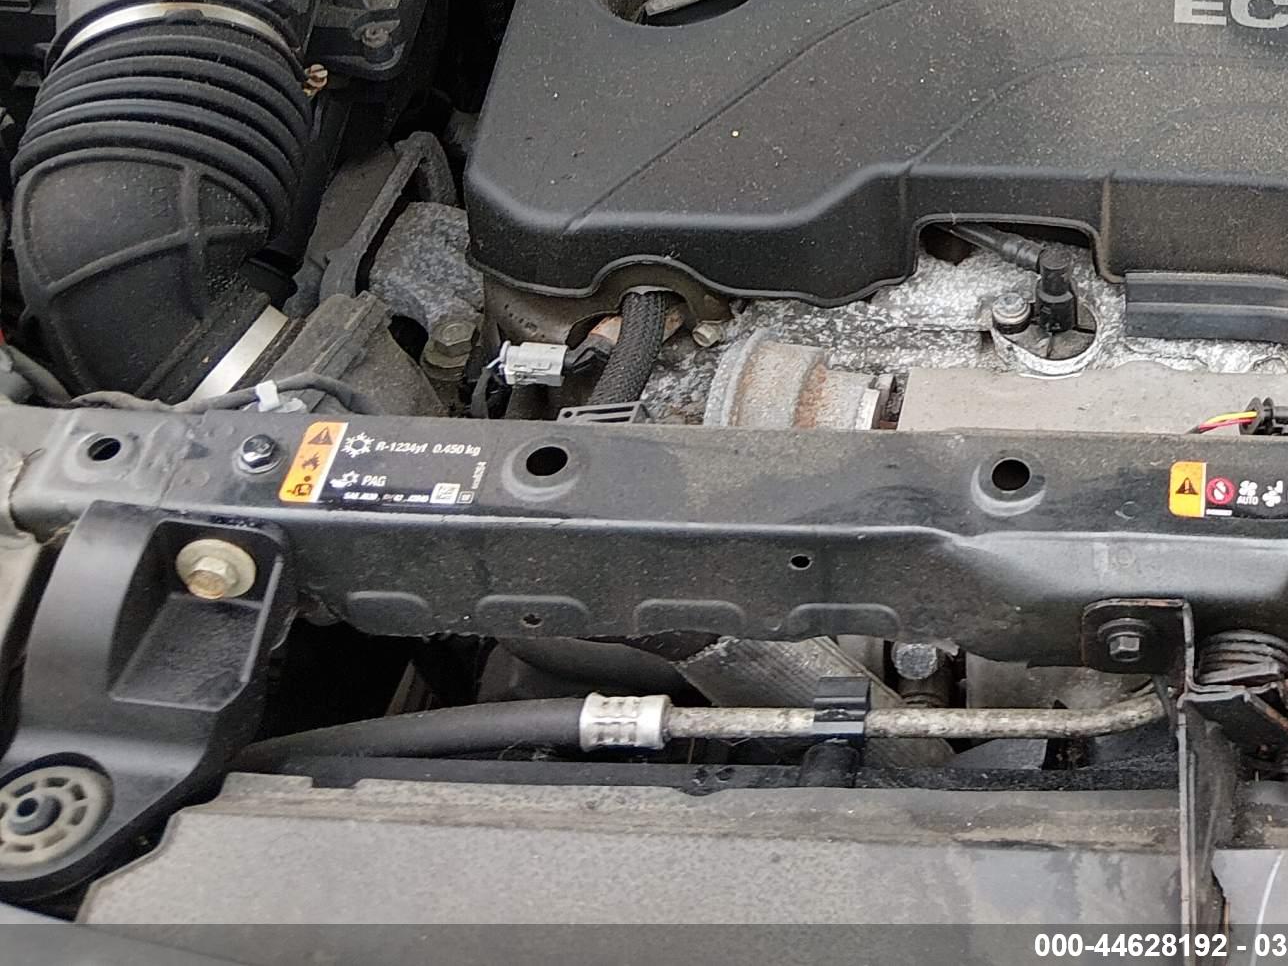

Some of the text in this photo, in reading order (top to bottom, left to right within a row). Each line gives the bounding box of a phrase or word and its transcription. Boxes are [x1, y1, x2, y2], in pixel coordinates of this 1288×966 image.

[375, 441, 481, 457] R-1234yf 0.450 kg
[362, 475, 387, 488] PAG
[1236, 496, 1259, 505] AUTO
